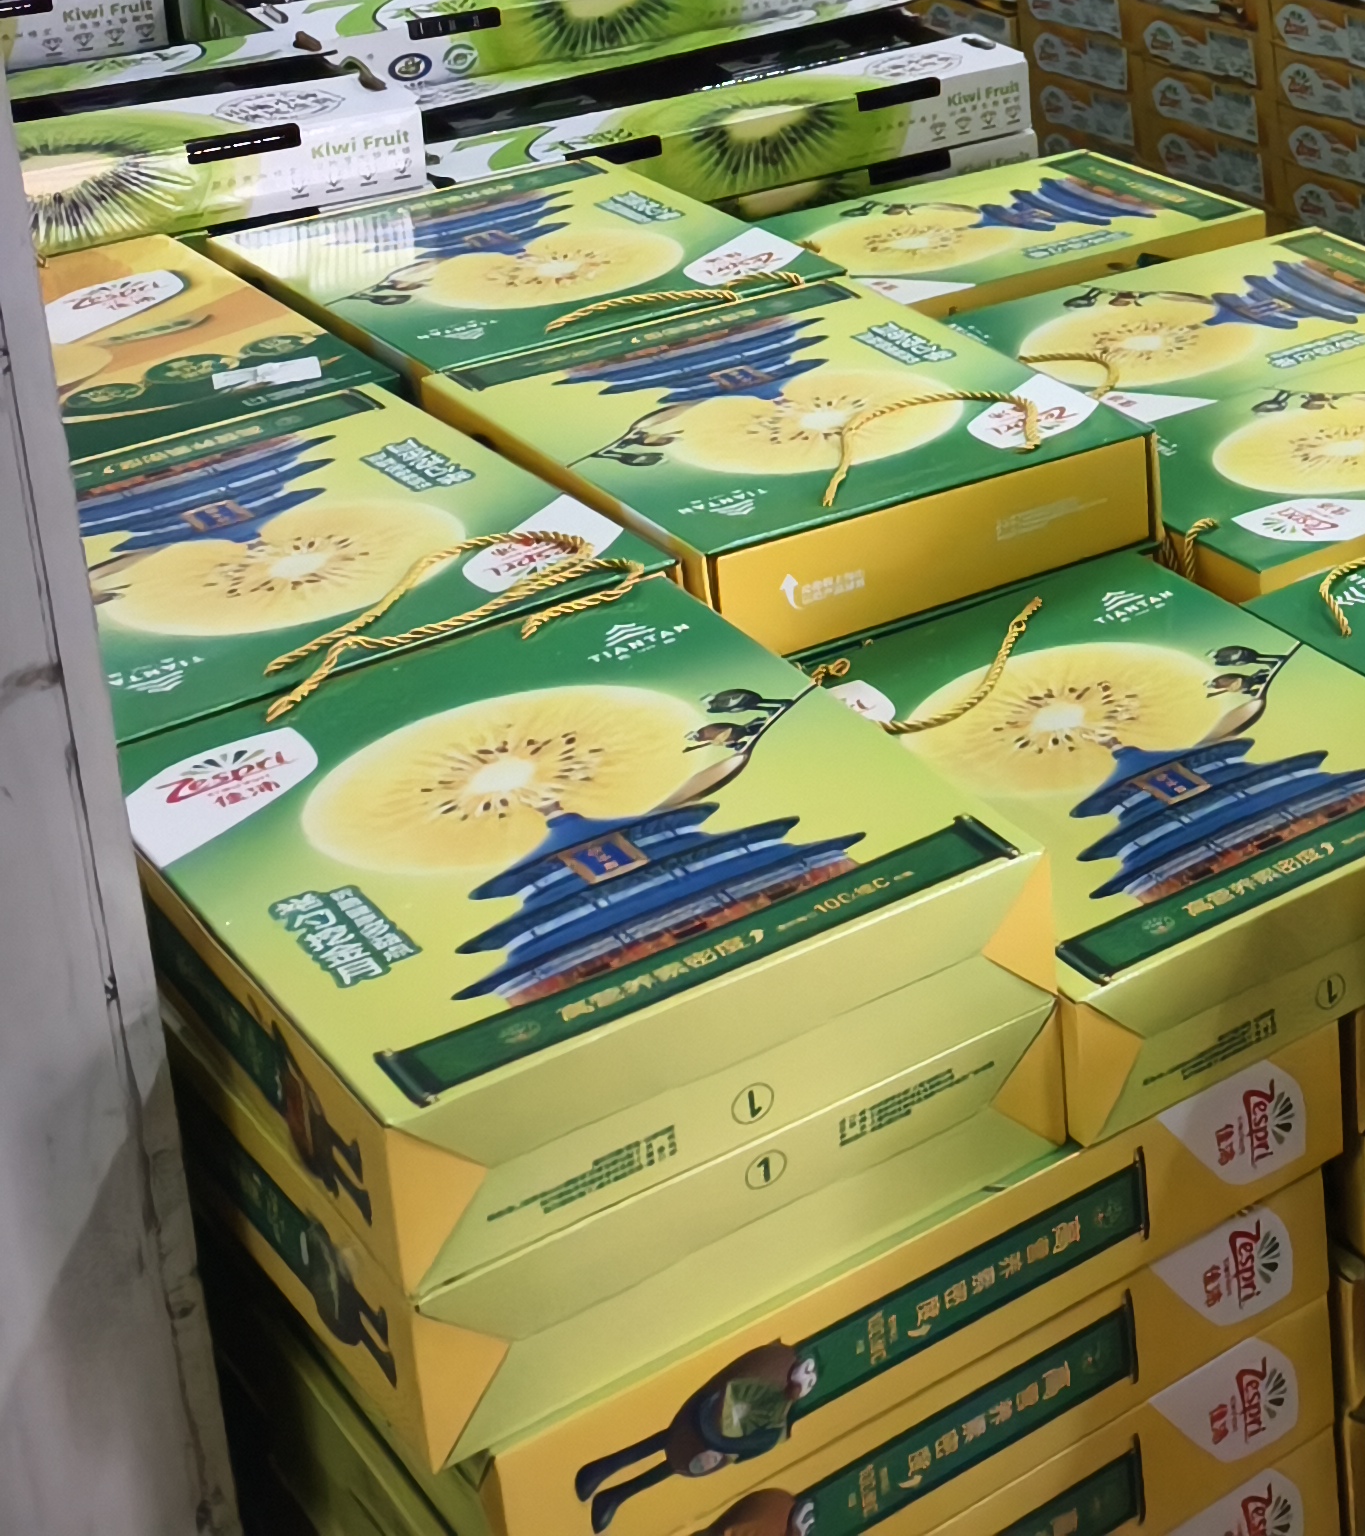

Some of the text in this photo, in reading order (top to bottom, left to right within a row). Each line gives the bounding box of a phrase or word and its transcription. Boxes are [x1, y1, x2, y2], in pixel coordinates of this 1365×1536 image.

[63, 0, 153, 23] Kiwi Fruit
[948, 81, 1020, 107] Kiwi Fruit
[311, 130, 410, 160] Kiwi Fruit
[1094, 589, 1174, 624] TIANTAN
[588, 621, 690, 662] TIANTAN
[156, 751, 290, 804] Zespri
[1242, 1078, 1274, 1169] Zespri
[1229, 1219, 1261, 1310] Zespri
[1236, 1356, 1267, 1443] Zespri
